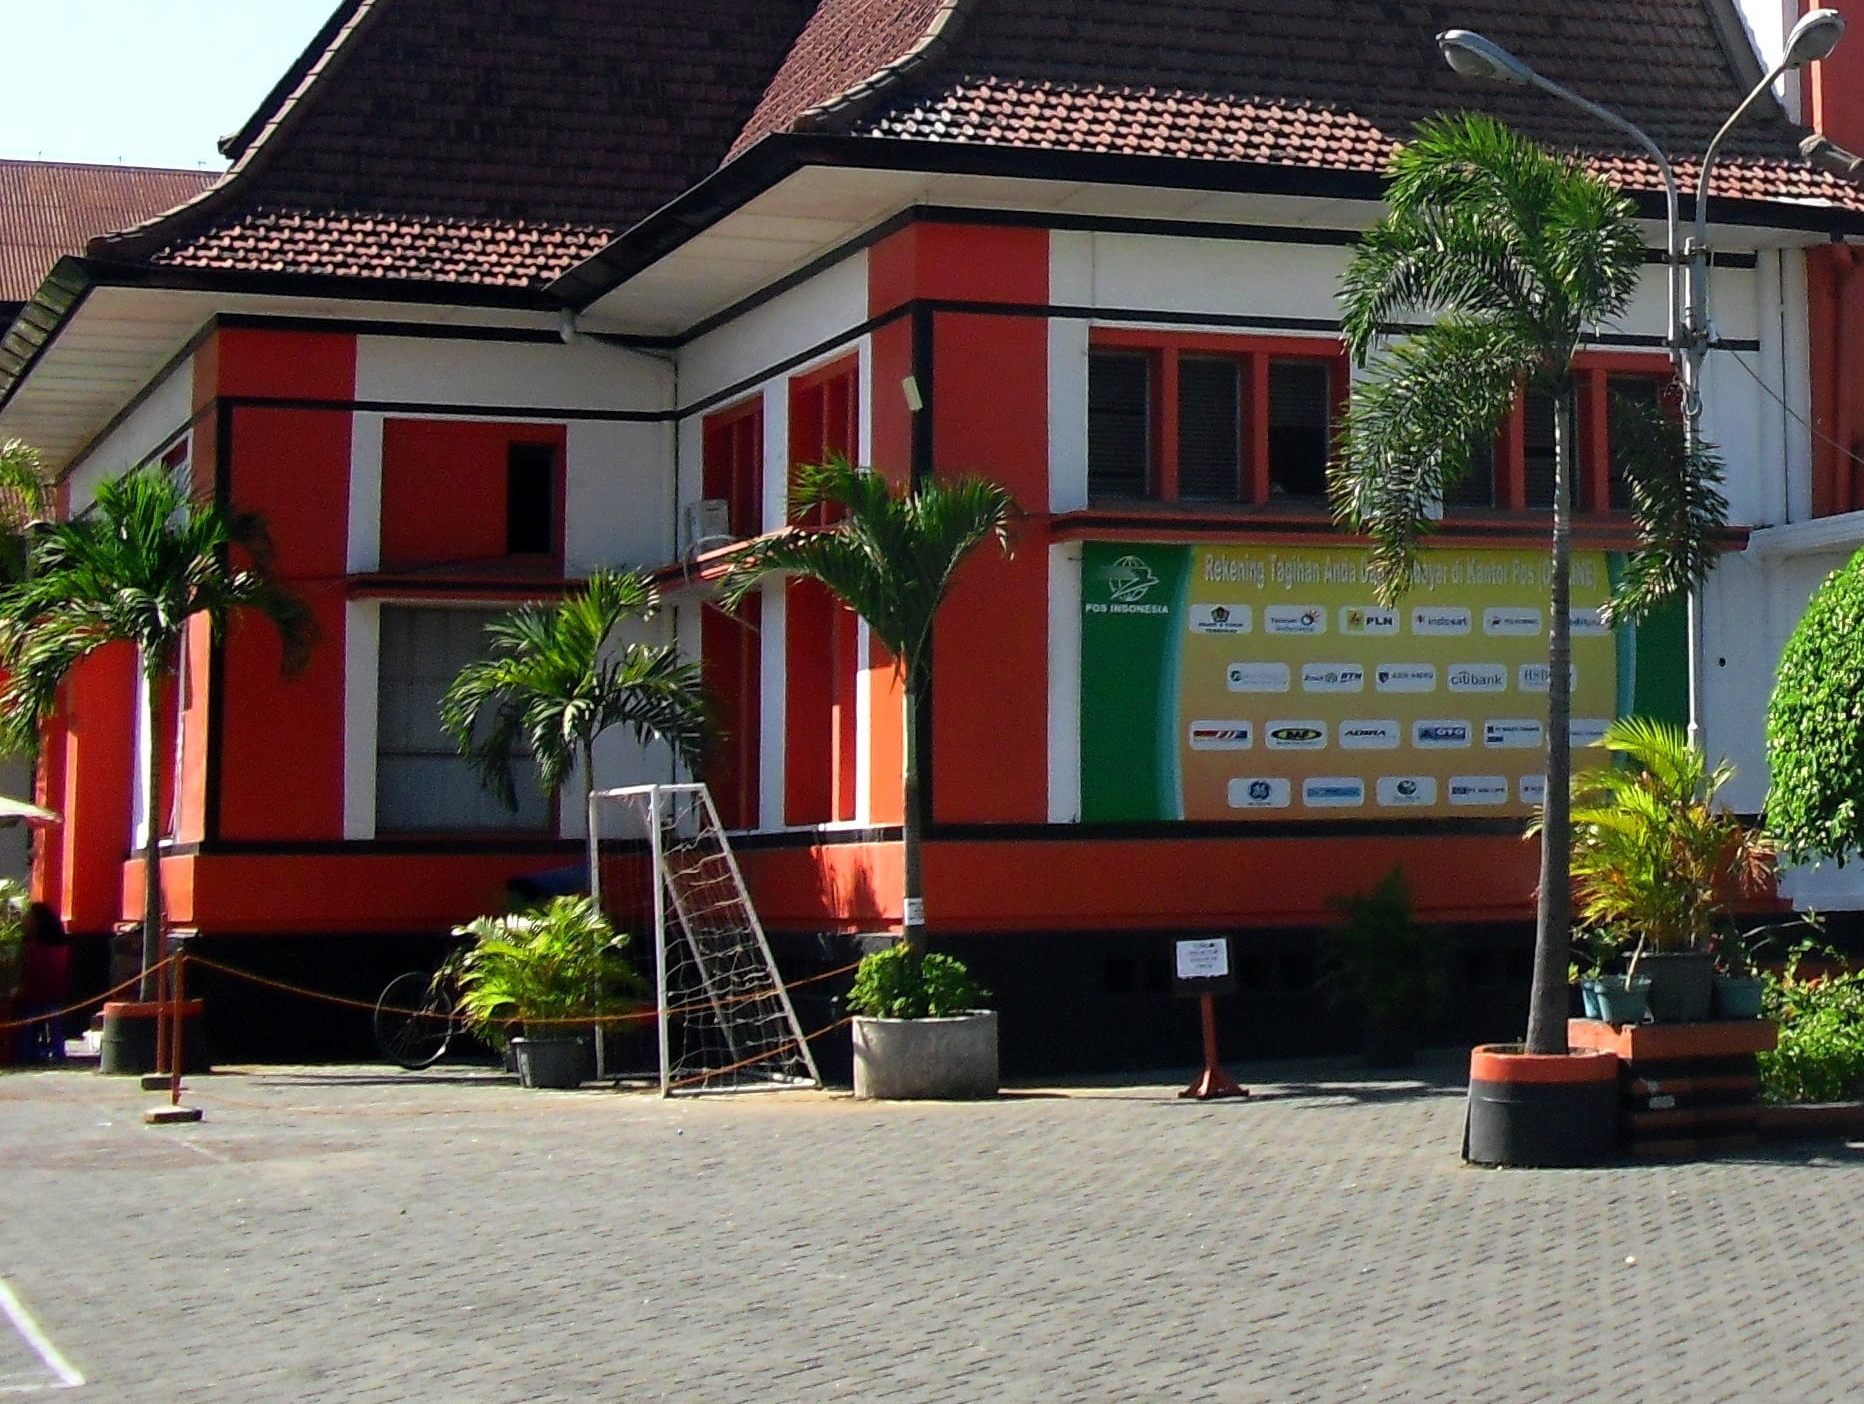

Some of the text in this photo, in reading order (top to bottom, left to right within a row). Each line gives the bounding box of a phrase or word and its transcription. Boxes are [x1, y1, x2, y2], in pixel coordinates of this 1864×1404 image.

[1205, 553, 1265, 589] Rekening
[1271, 554, 1320, 590] Tagihan
[1323, 556, 1356, 584] Anda
[1466, 557, 1508, 586] Kantor
[1513, 559, 1535, 586] Pos
[1085, 603, 1169, 614] POS INDONESIA
[1366, 617, 1393, 626] PLN
[1450, 670, 1503, 686] citibank
[1524, 668, 1551, 681] HSB
